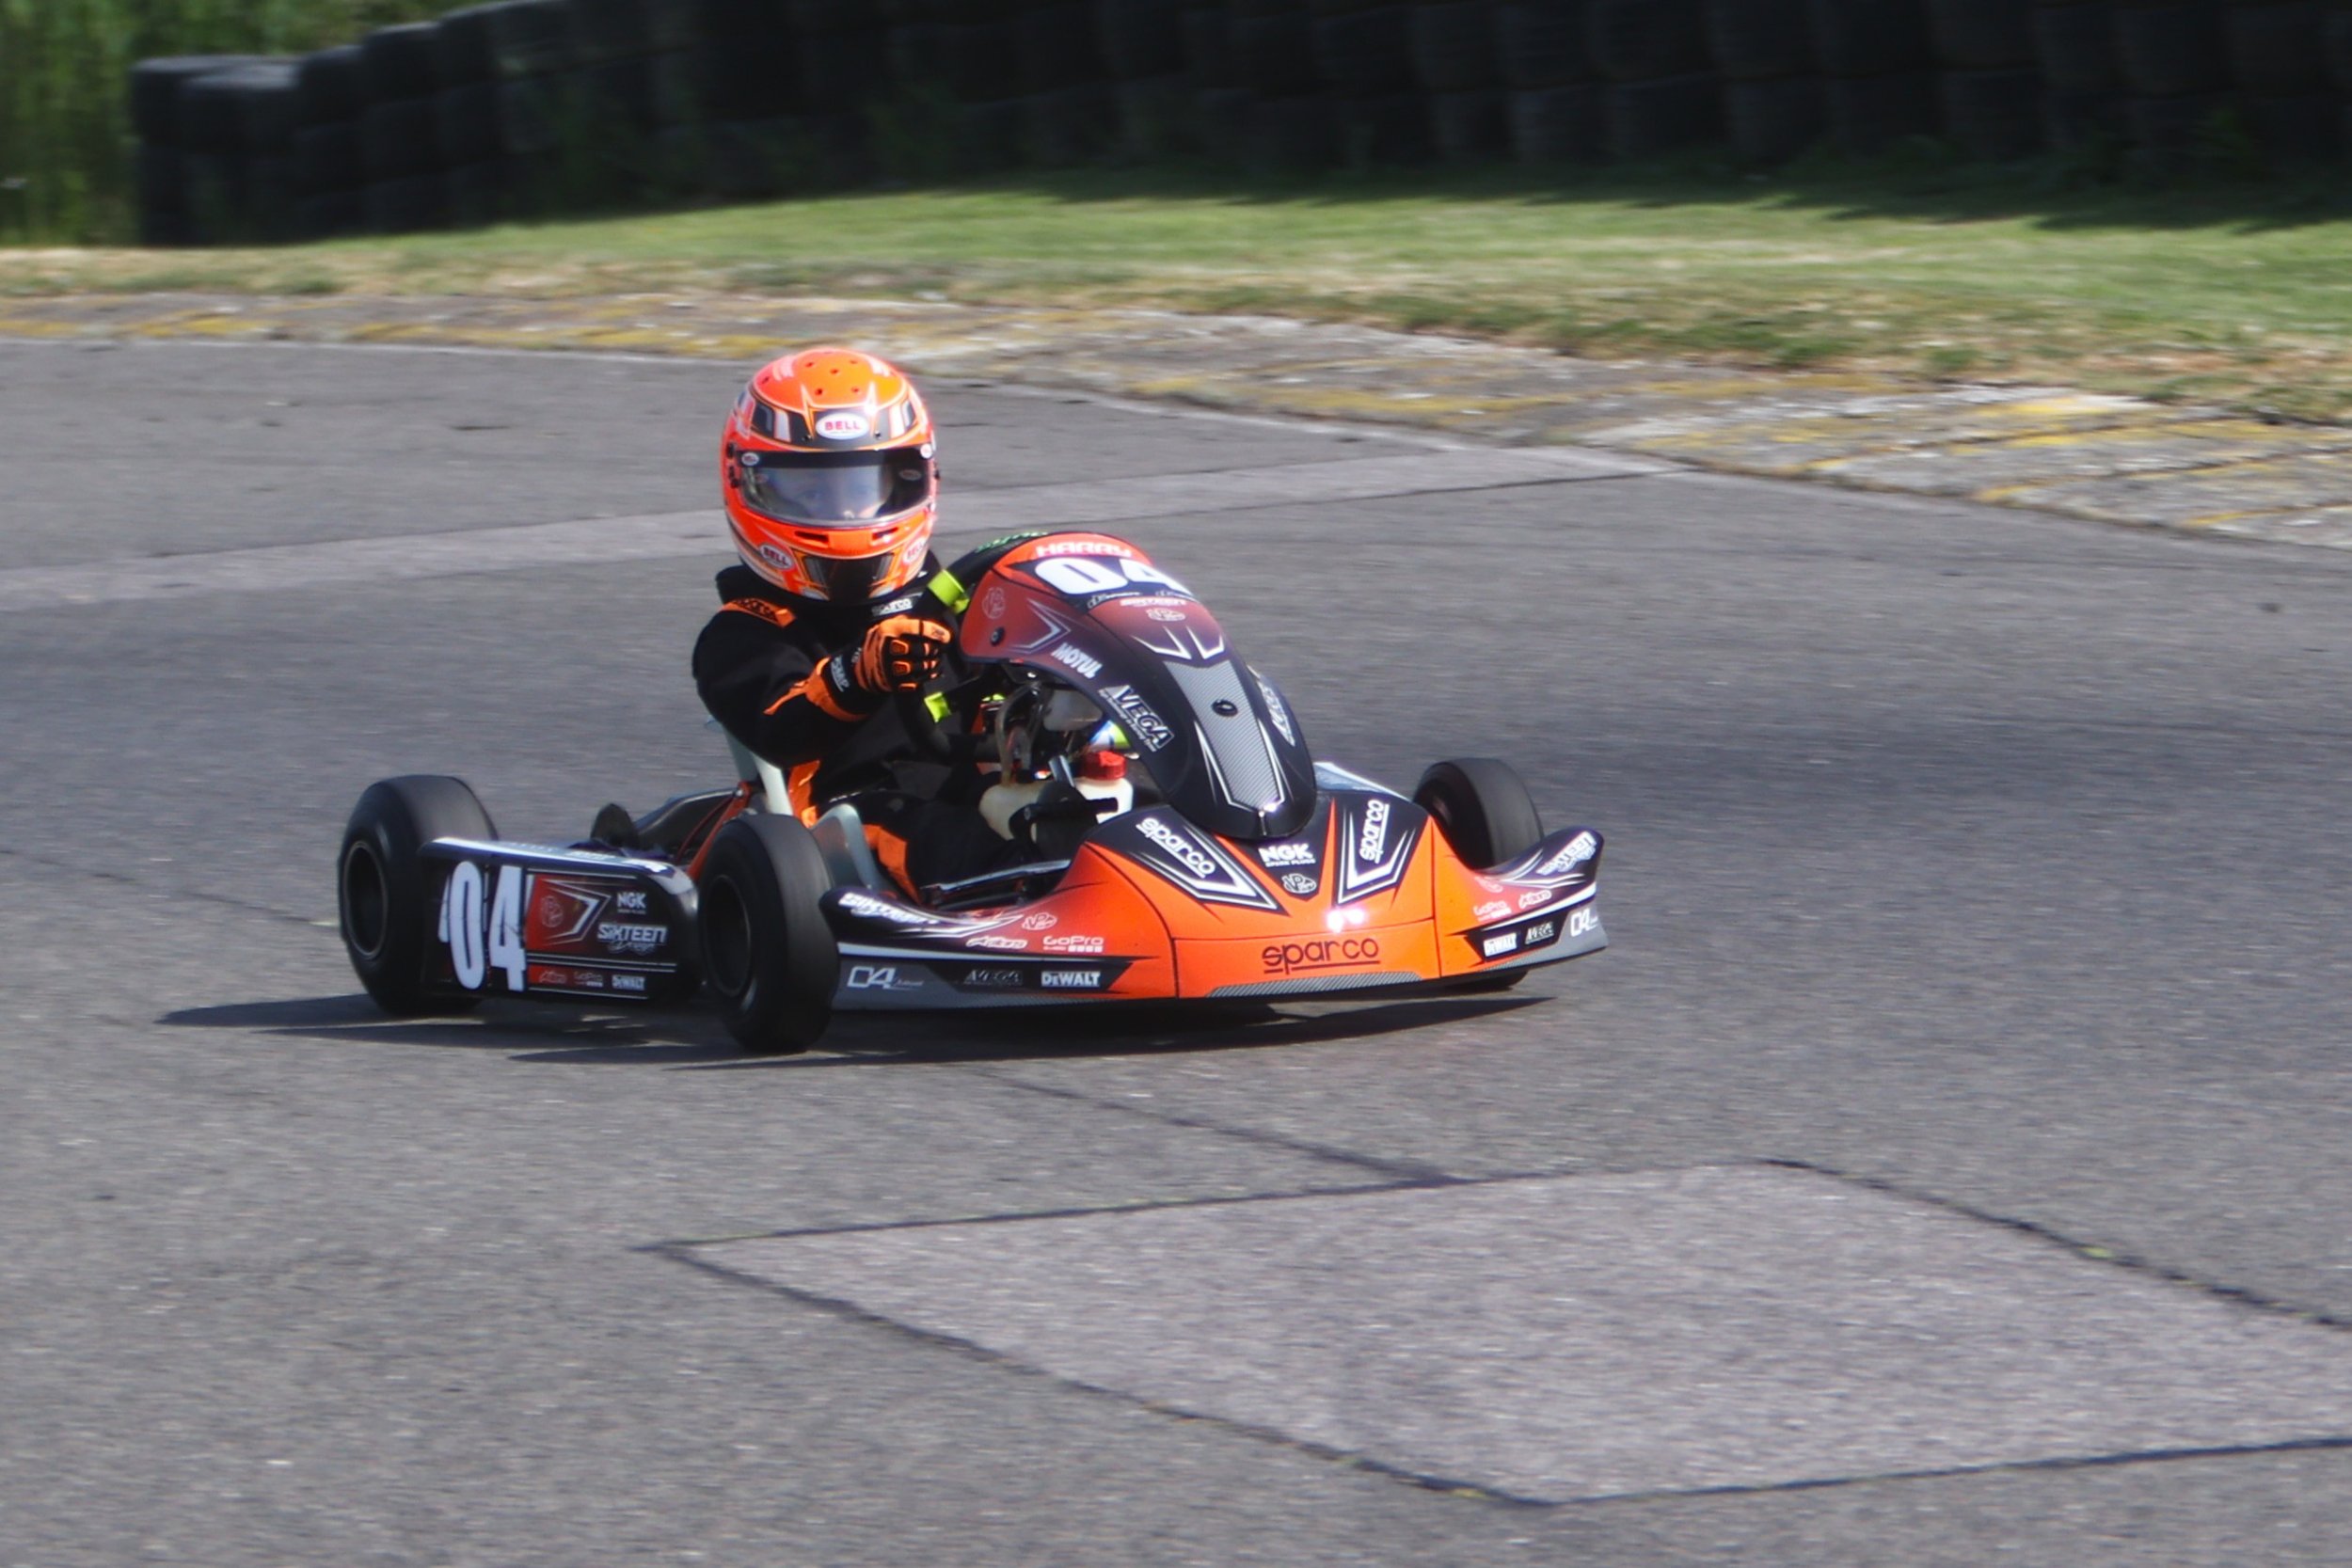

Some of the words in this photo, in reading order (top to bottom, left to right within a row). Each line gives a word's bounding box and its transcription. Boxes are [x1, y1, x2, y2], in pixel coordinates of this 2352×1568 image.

[825, 420, 861, 432] BELL
[763, 547, 790, 565] BELL
[907, 540, 925, 560] BELL
[1036, 542, 1132, 558] HARRY
[1035, 557, 1193, 594] 04
[1051, 641, 1103, 678] MOTUL
[1104, 685, 1174, 749] VEGA
[1359, 800, 1390, 863] sparco
[1136, 816, 1216, 879] sparco
[1258, 844, 1313, 862] NGK
[617, 892, 646, 908] NGK
[449, 861, 526, 991] 04
[1570, 908, 1592, 937] 04
[1042, 936, 1104, 946] GoPro
[1262, 938, 1380, 974] sparco
[848, 966, 896, 989] 04
